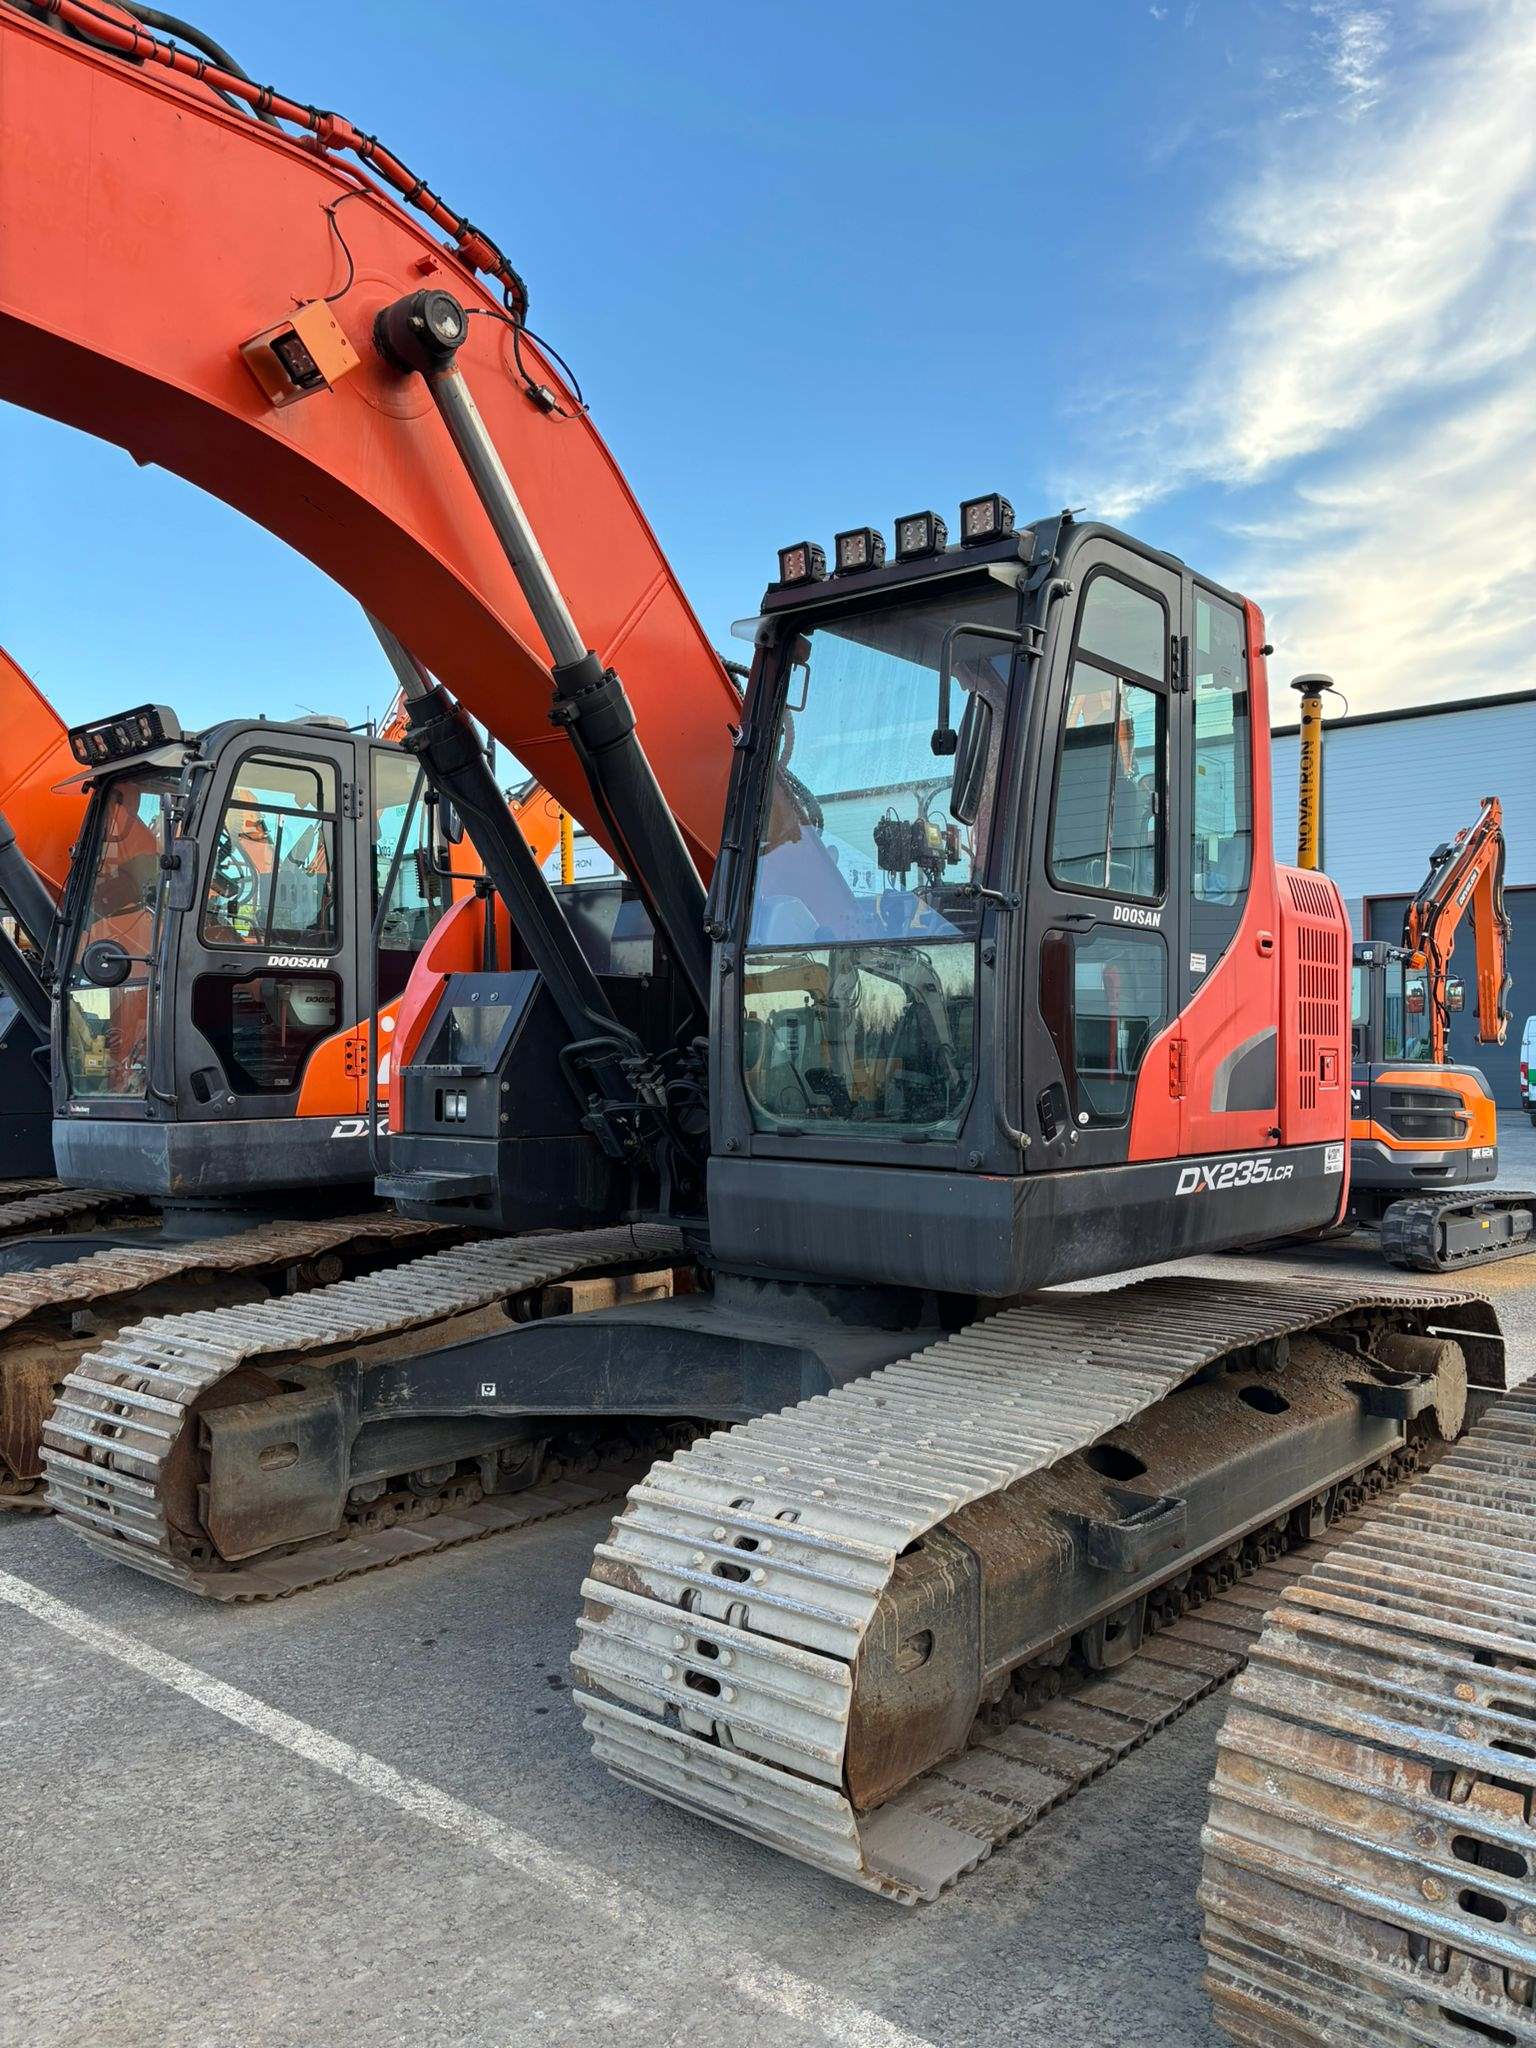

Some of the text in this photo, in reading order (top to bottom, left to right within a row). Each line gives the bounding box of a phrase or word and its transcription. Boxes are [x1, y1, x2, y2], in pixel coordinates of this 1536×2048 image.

[1298, 741, 1313, 852] NOVATRON
[1113, 905, 1161, 927] DOOSAN
[267, 956, 330, 968] DOOSAN
[331, 1119, 396, 1138] DX
